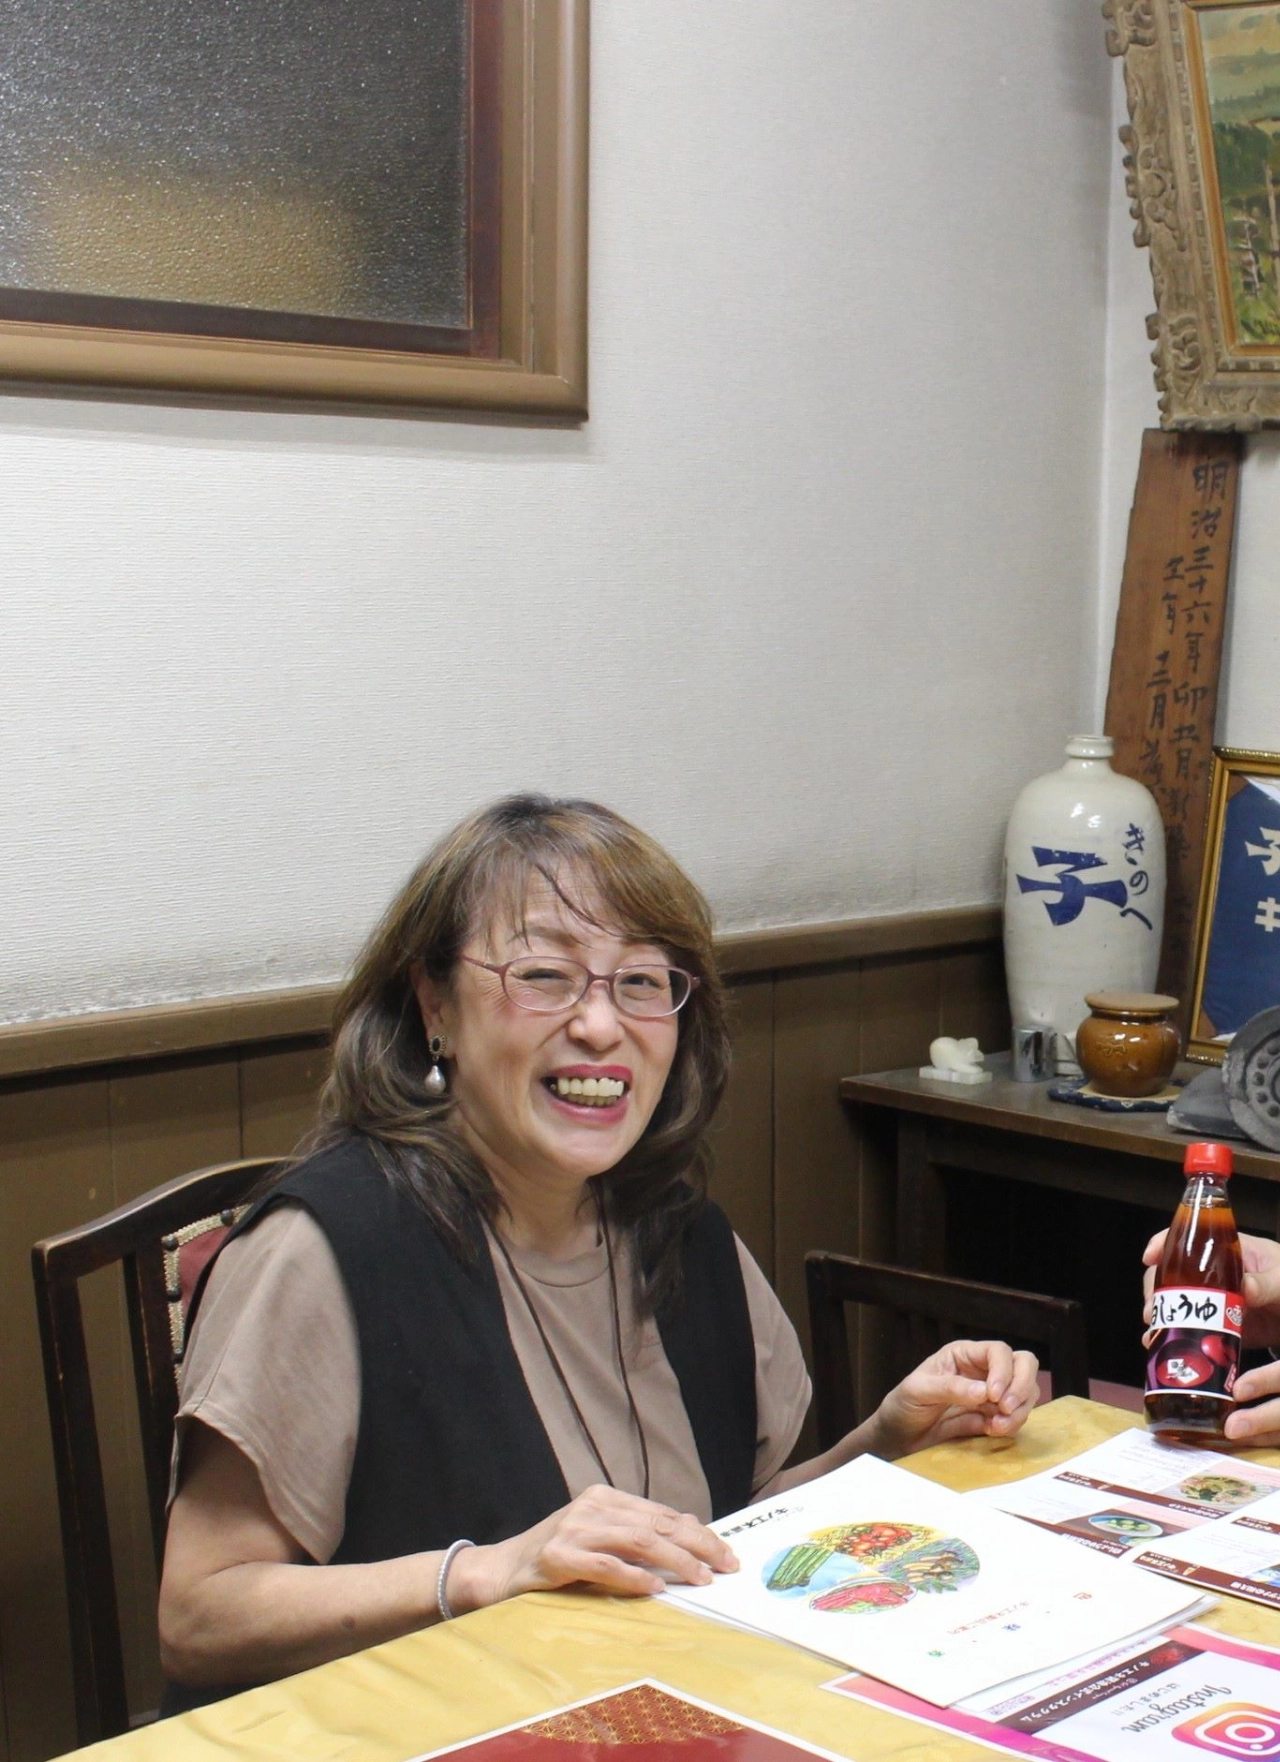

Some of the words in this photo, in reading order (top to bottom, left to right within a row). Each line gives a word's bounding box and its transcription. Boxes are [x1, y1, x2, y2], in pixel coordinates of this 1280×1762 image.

[1120, 822, 1154, 931] きのへ
[1121, 1684, 1233, 1733] Instagram
